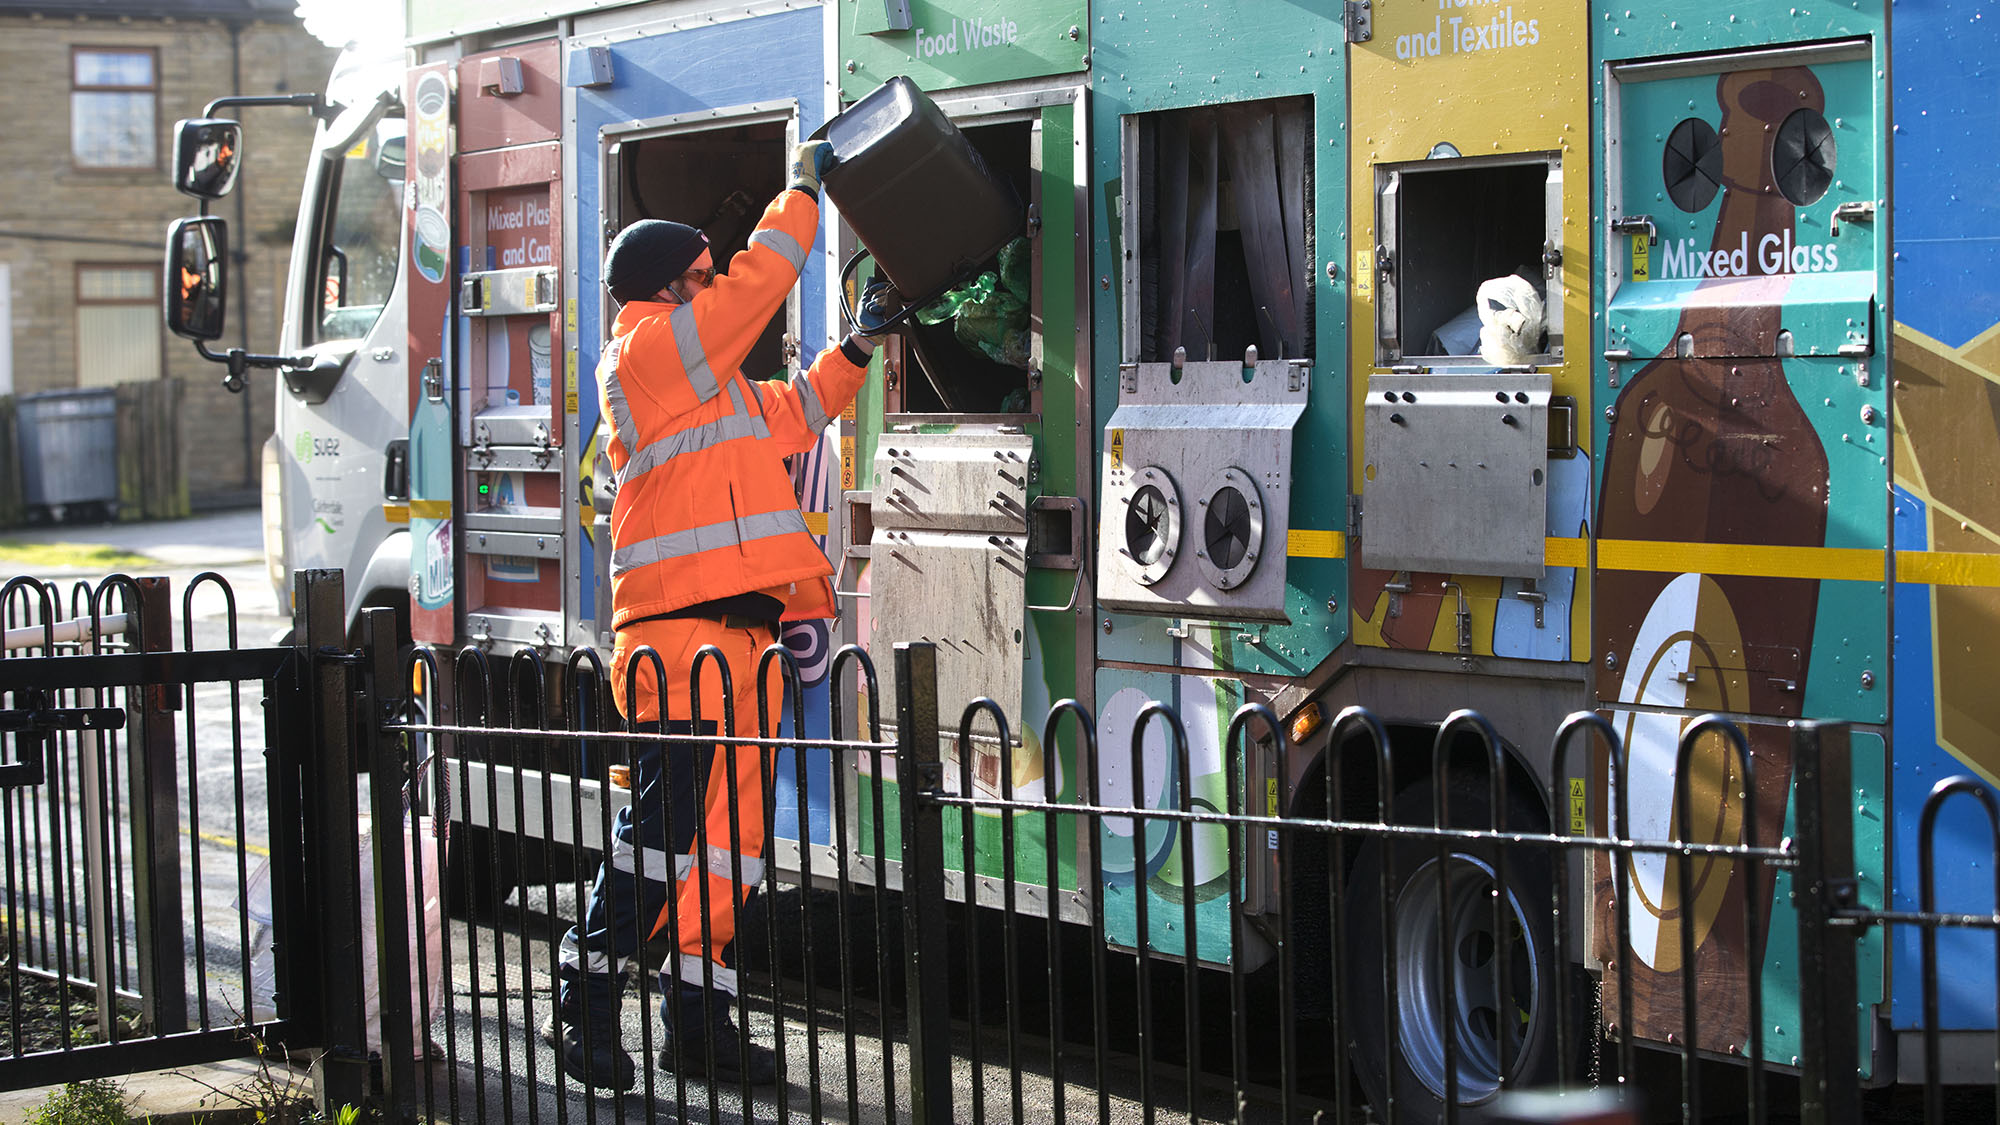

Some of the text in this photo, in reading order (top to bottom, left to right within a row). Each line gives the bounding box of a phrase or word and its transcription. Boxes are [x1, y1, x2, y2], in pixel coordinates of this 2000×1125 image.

[915, 16, 1018, 59] Food Waste
[1396, 6, 1540, 59] and Textiles
[487, 199, 550, 231] Mixed Plas
[502, 236, 551, 266] and Can
[1661, 230, 1839, 279] Mixed Glass
[314, 437, 340, 456] suez
